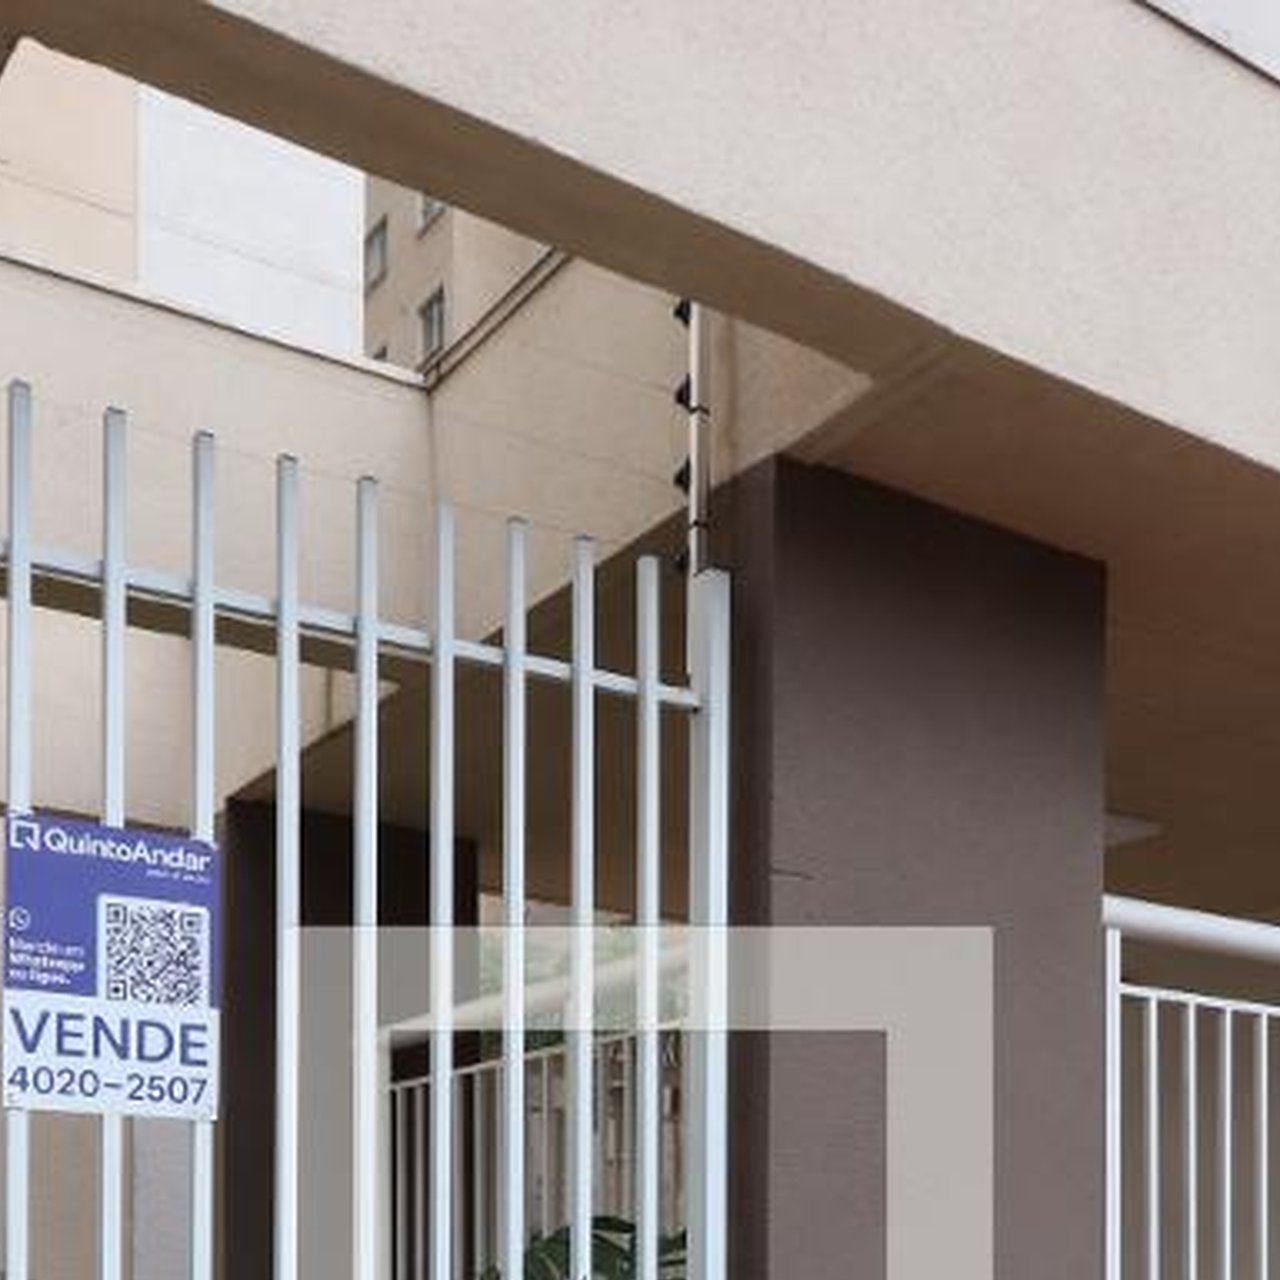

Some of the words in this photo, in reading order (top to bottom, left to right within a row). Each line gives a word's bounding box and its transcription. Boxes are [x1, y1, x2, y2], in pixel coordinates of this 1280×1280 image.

[43, 827, 211, 871] QuintoAndar
[9, 1007, 208, 1068] VENDE
[7, 1065, 208, 1105] 4020-2507
